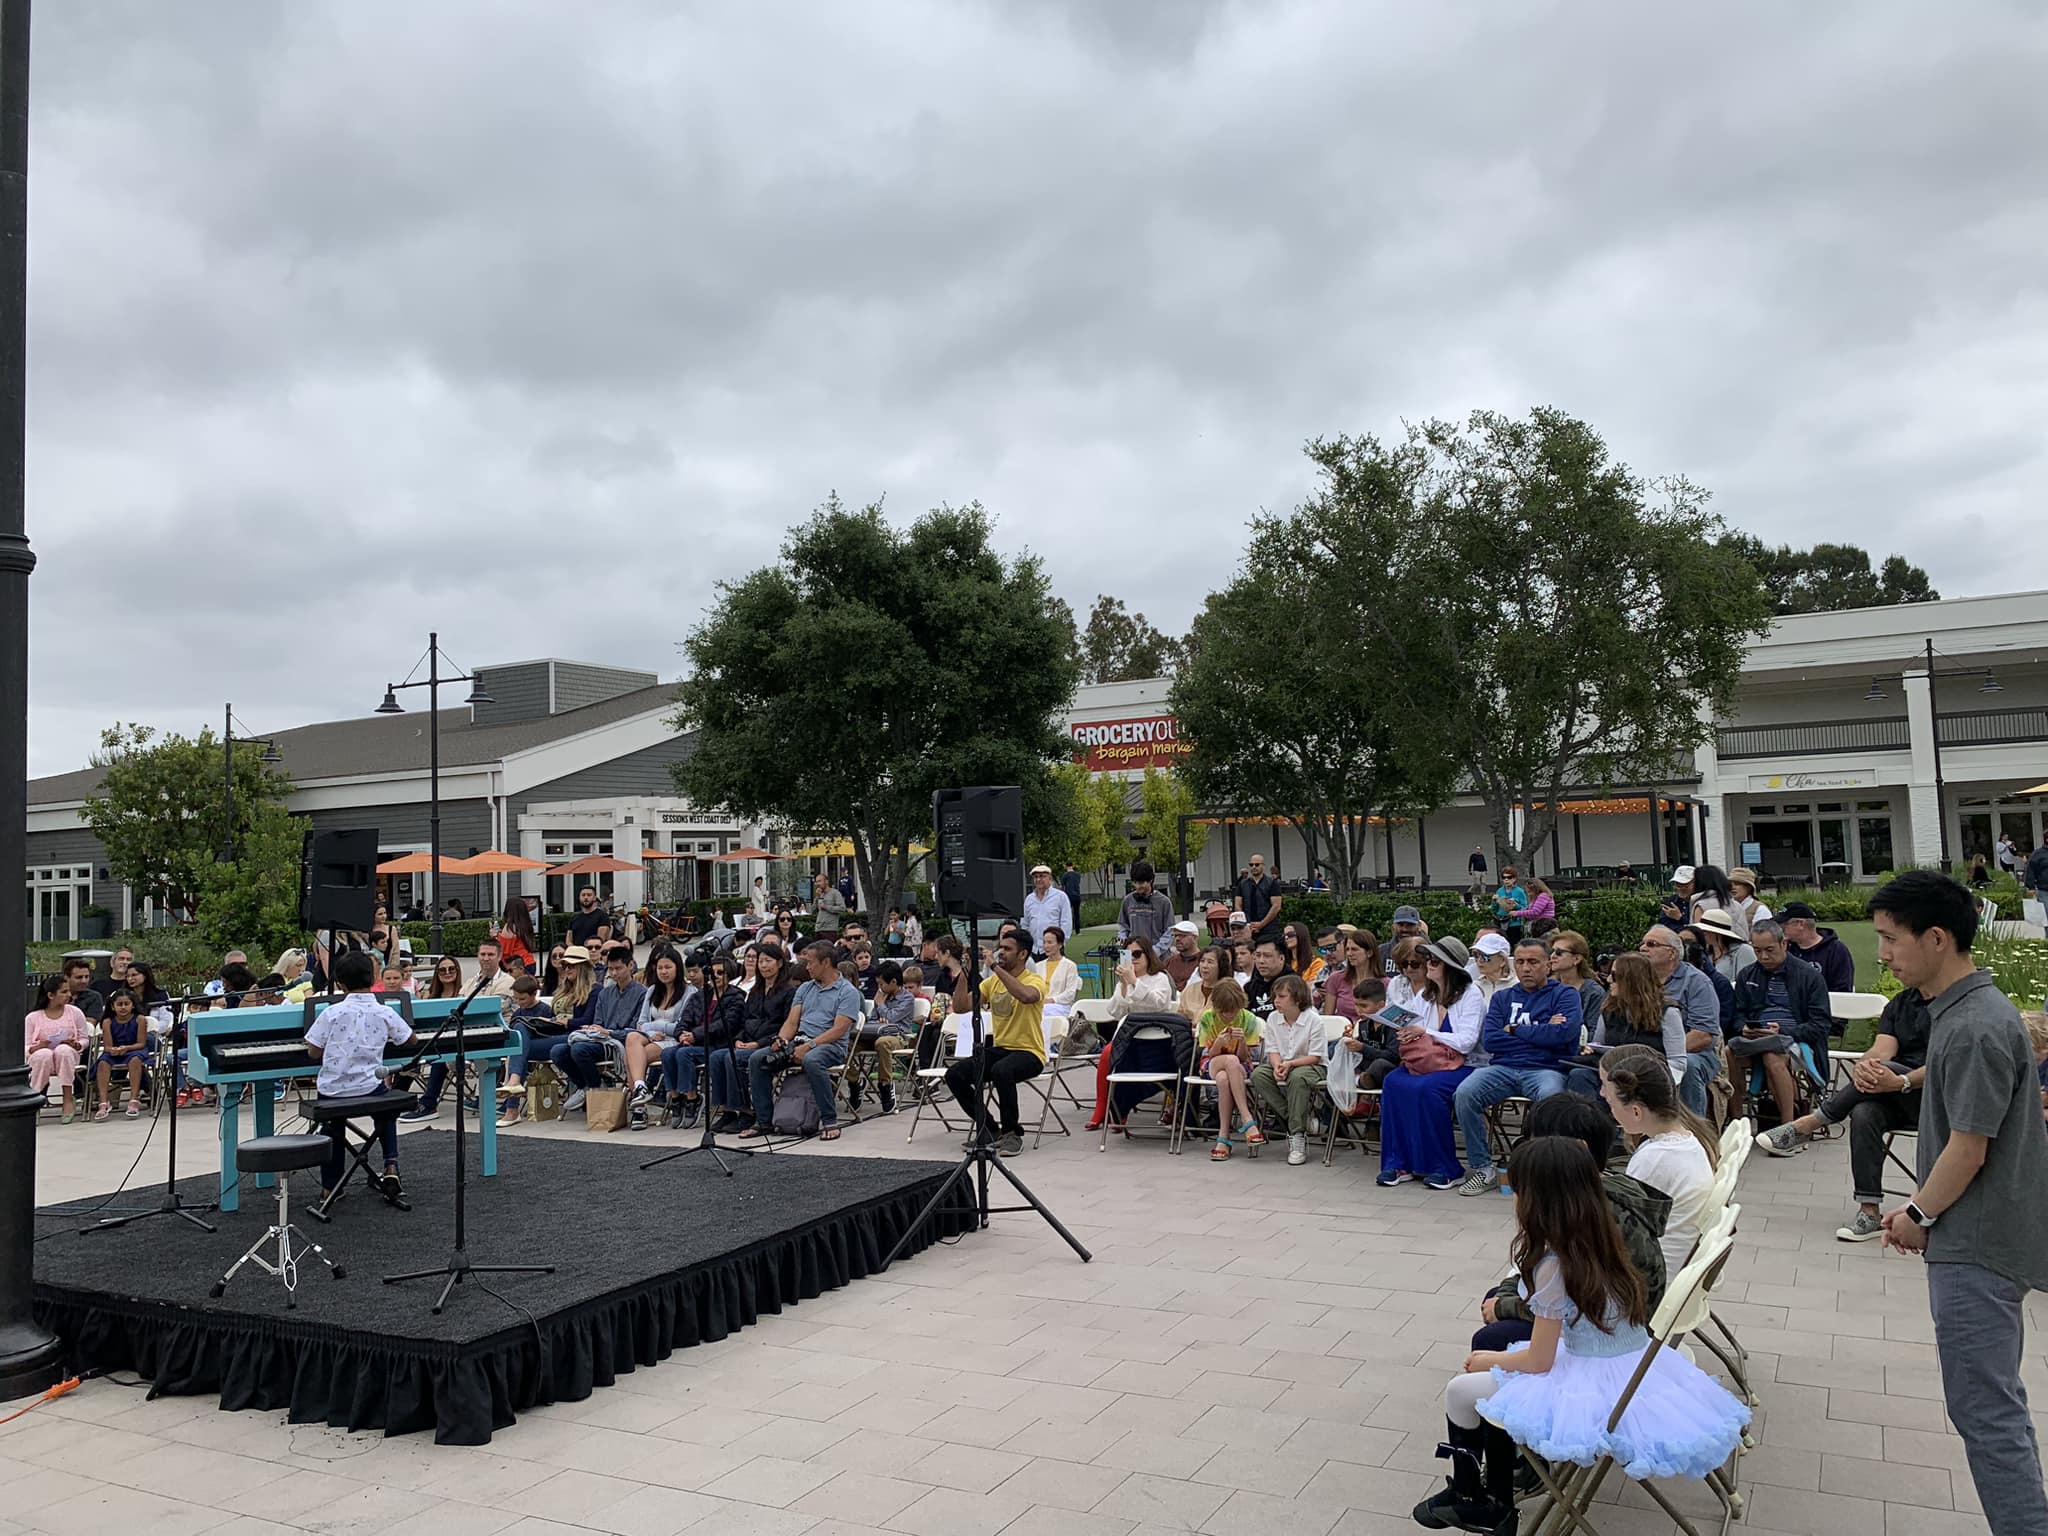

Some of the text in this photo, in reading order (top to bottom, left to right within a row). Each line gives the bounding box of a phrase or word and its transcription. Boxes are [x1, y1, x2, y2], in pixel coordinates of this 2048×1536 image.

[1096, 743, 1149, 764] bargain
[662, 814, 688, 824] SESSIONS
[689, 815, 703, 824] WEST
[704, 815, 720, 824] COAST
